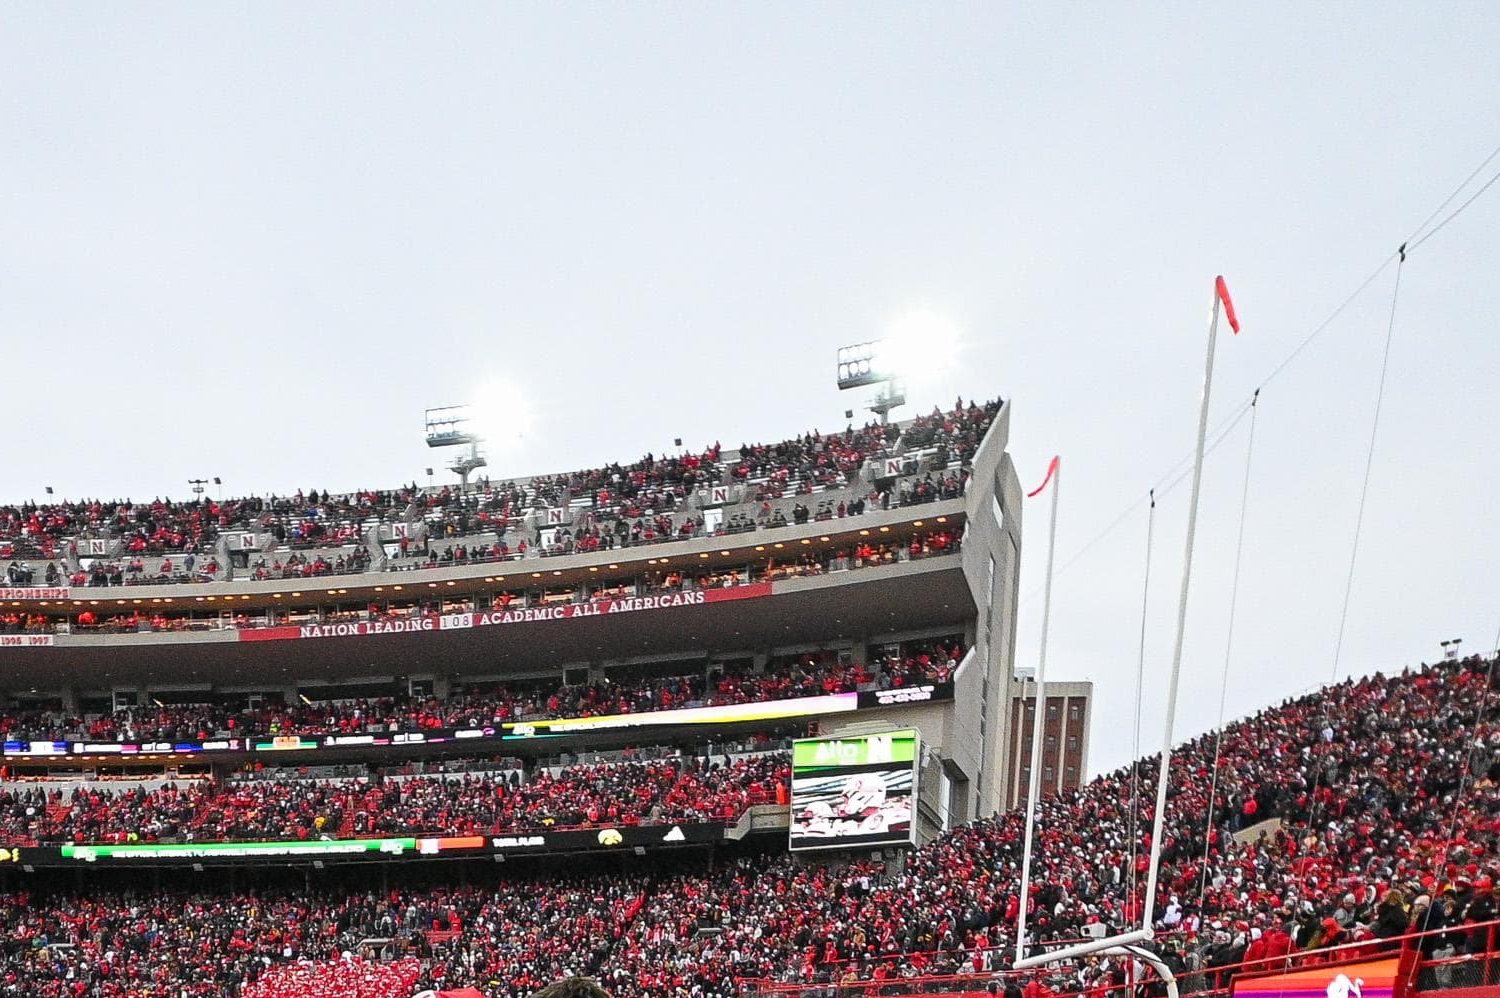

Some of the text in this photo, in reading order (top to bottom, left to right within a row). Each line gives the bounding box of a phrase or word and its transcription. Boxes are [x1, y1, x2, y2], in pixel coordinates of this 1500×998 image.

[888, 461, 901, 474] N
[714, 489, 727, 501] N
[550, 510, 562, 522] N
[394, 525, 406, 536] N
[92, 541, 104, 552] N
[243, 536, 255, 547] N
[300, 591, 705, 638] NATION LEADING 108 ACADEMIC ALL AMERICANS
